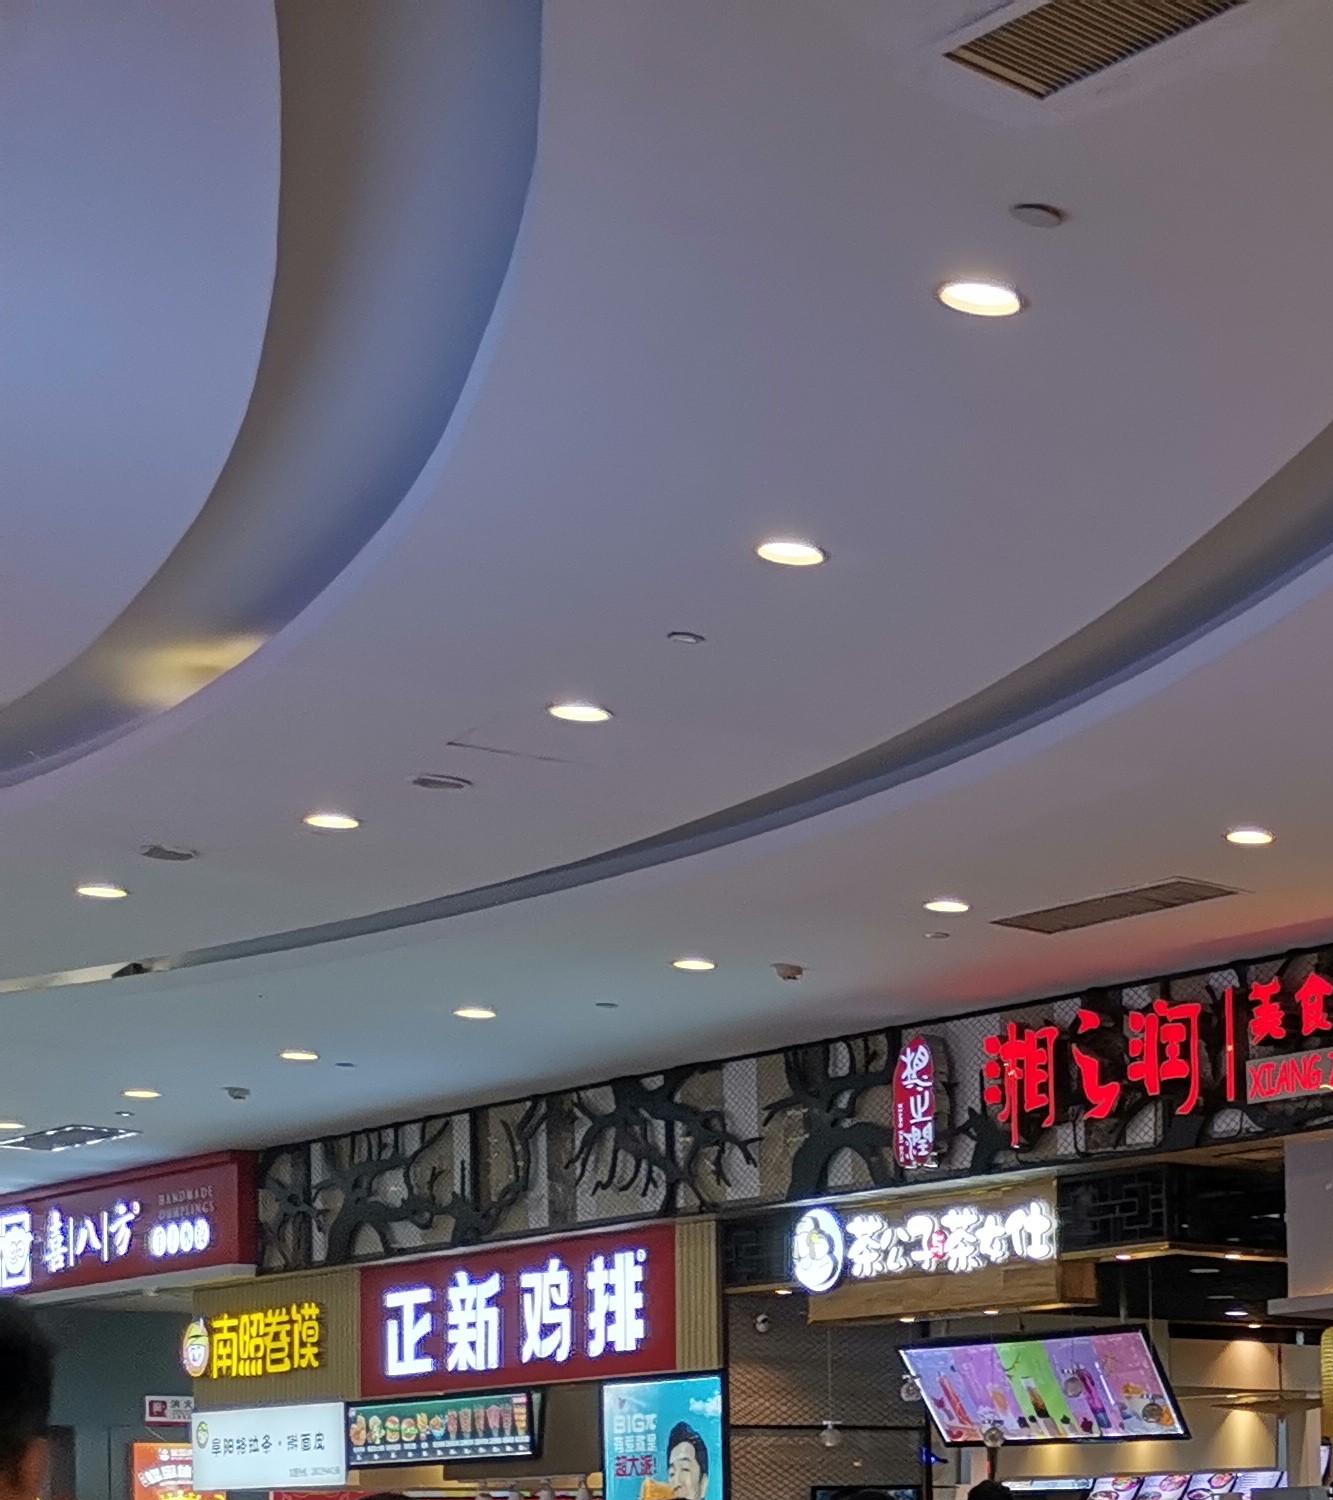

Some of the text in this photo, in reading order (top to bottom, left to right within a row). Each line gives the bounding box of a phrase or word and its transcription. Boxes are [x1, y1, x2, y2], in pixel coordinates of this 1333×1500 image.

[1249, 1059, 1323, 1099] XIANG
[210, 1303, 320, 1379] 南照卷馍
[382, 1250, 646, 1377] 正新鸡排
